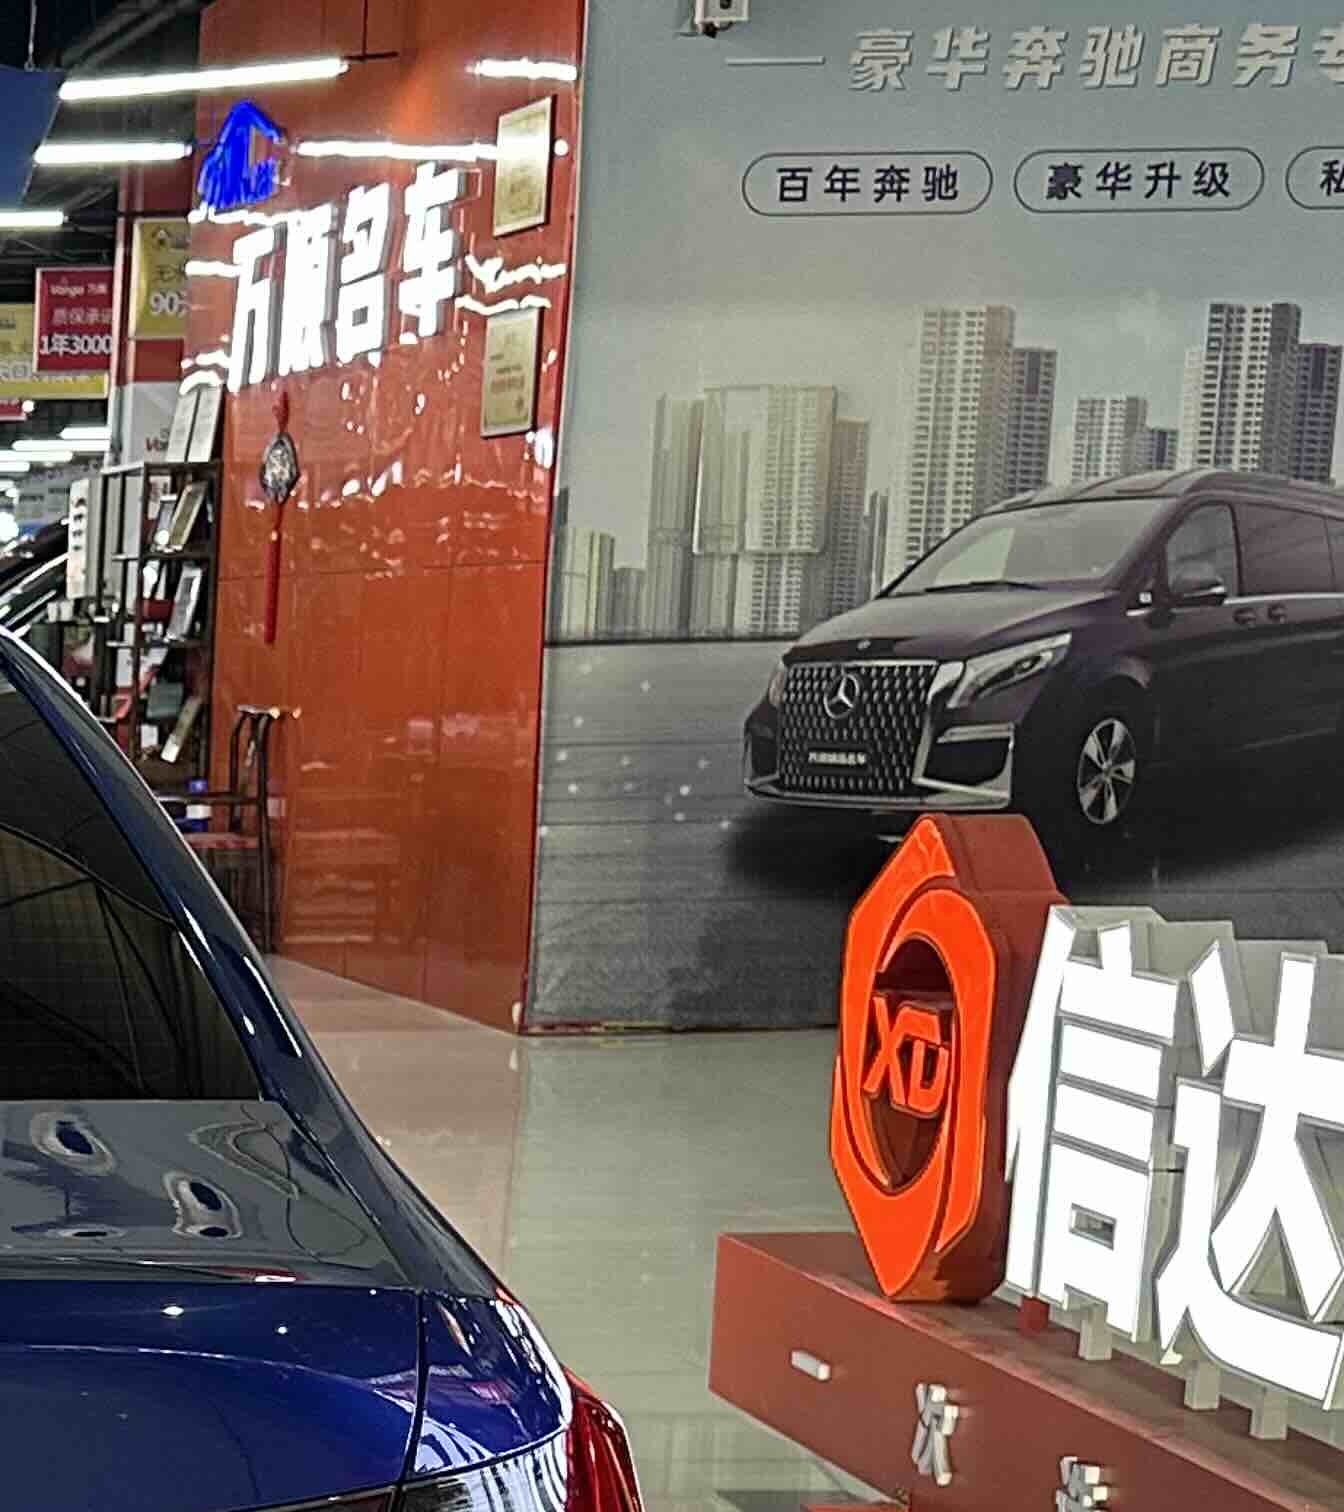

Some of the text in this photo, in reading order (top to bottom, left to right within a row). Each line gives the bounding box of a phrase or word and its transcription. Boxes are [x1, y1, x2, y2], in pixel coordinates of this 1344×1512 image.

[776, 164, 959, 202] 百年奔驰
[1046, 161, 1230, 200] 豪华升级
[226, 161, 462, 393] 万顺名车
[1006, 905, 1344, 1409] 信达
